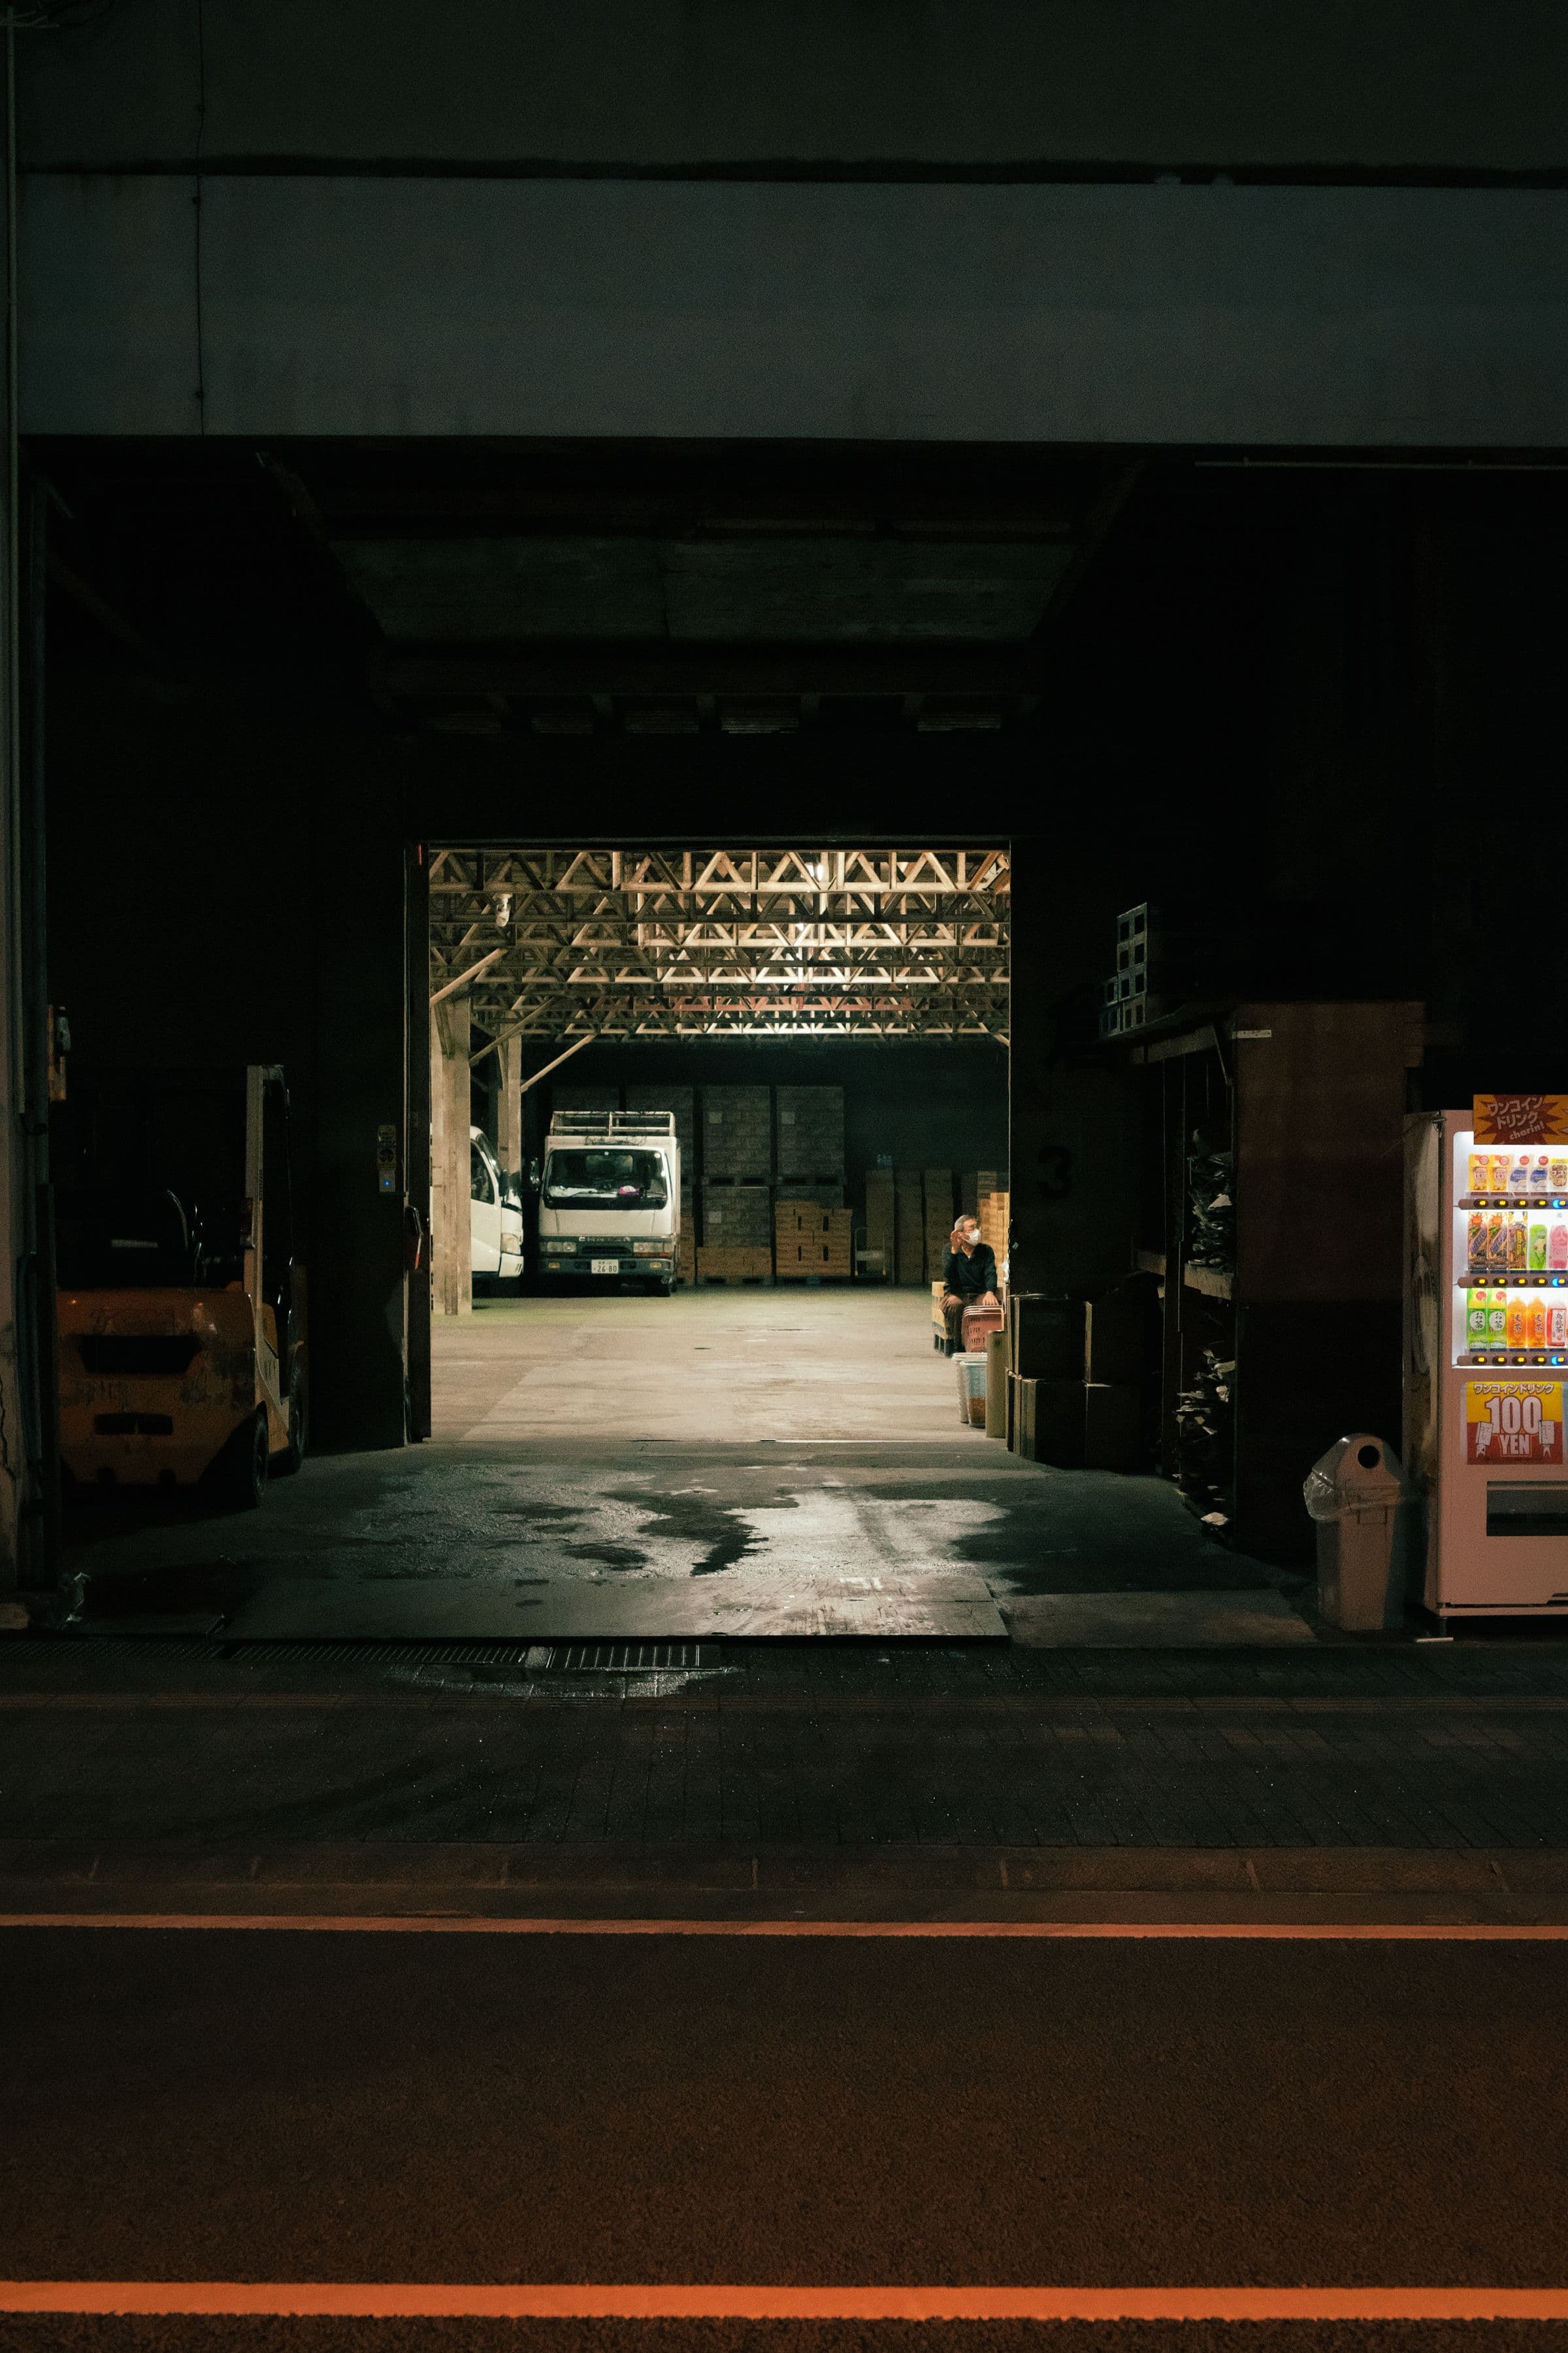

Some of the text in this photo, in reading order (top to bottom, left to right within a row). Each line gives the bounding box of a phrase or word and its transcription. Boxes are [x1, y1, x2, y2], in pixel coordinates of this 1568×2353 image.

[1488, 1097, 1543, 1116] ワンコイン
[1497, 1111, 1538, 1130] ドリンク
[1038, 1146, 1071, 1198] 3
[1475, 1312, 1483, 1328] お茶
[1495, 1312, 1503, 1328] お茶
[1474, 1383, 1554, 1394] ワンコインドリンク
[1485, 1395, 1543, 1434] 100
[1499, 1434, 1529, 1455] YEN
